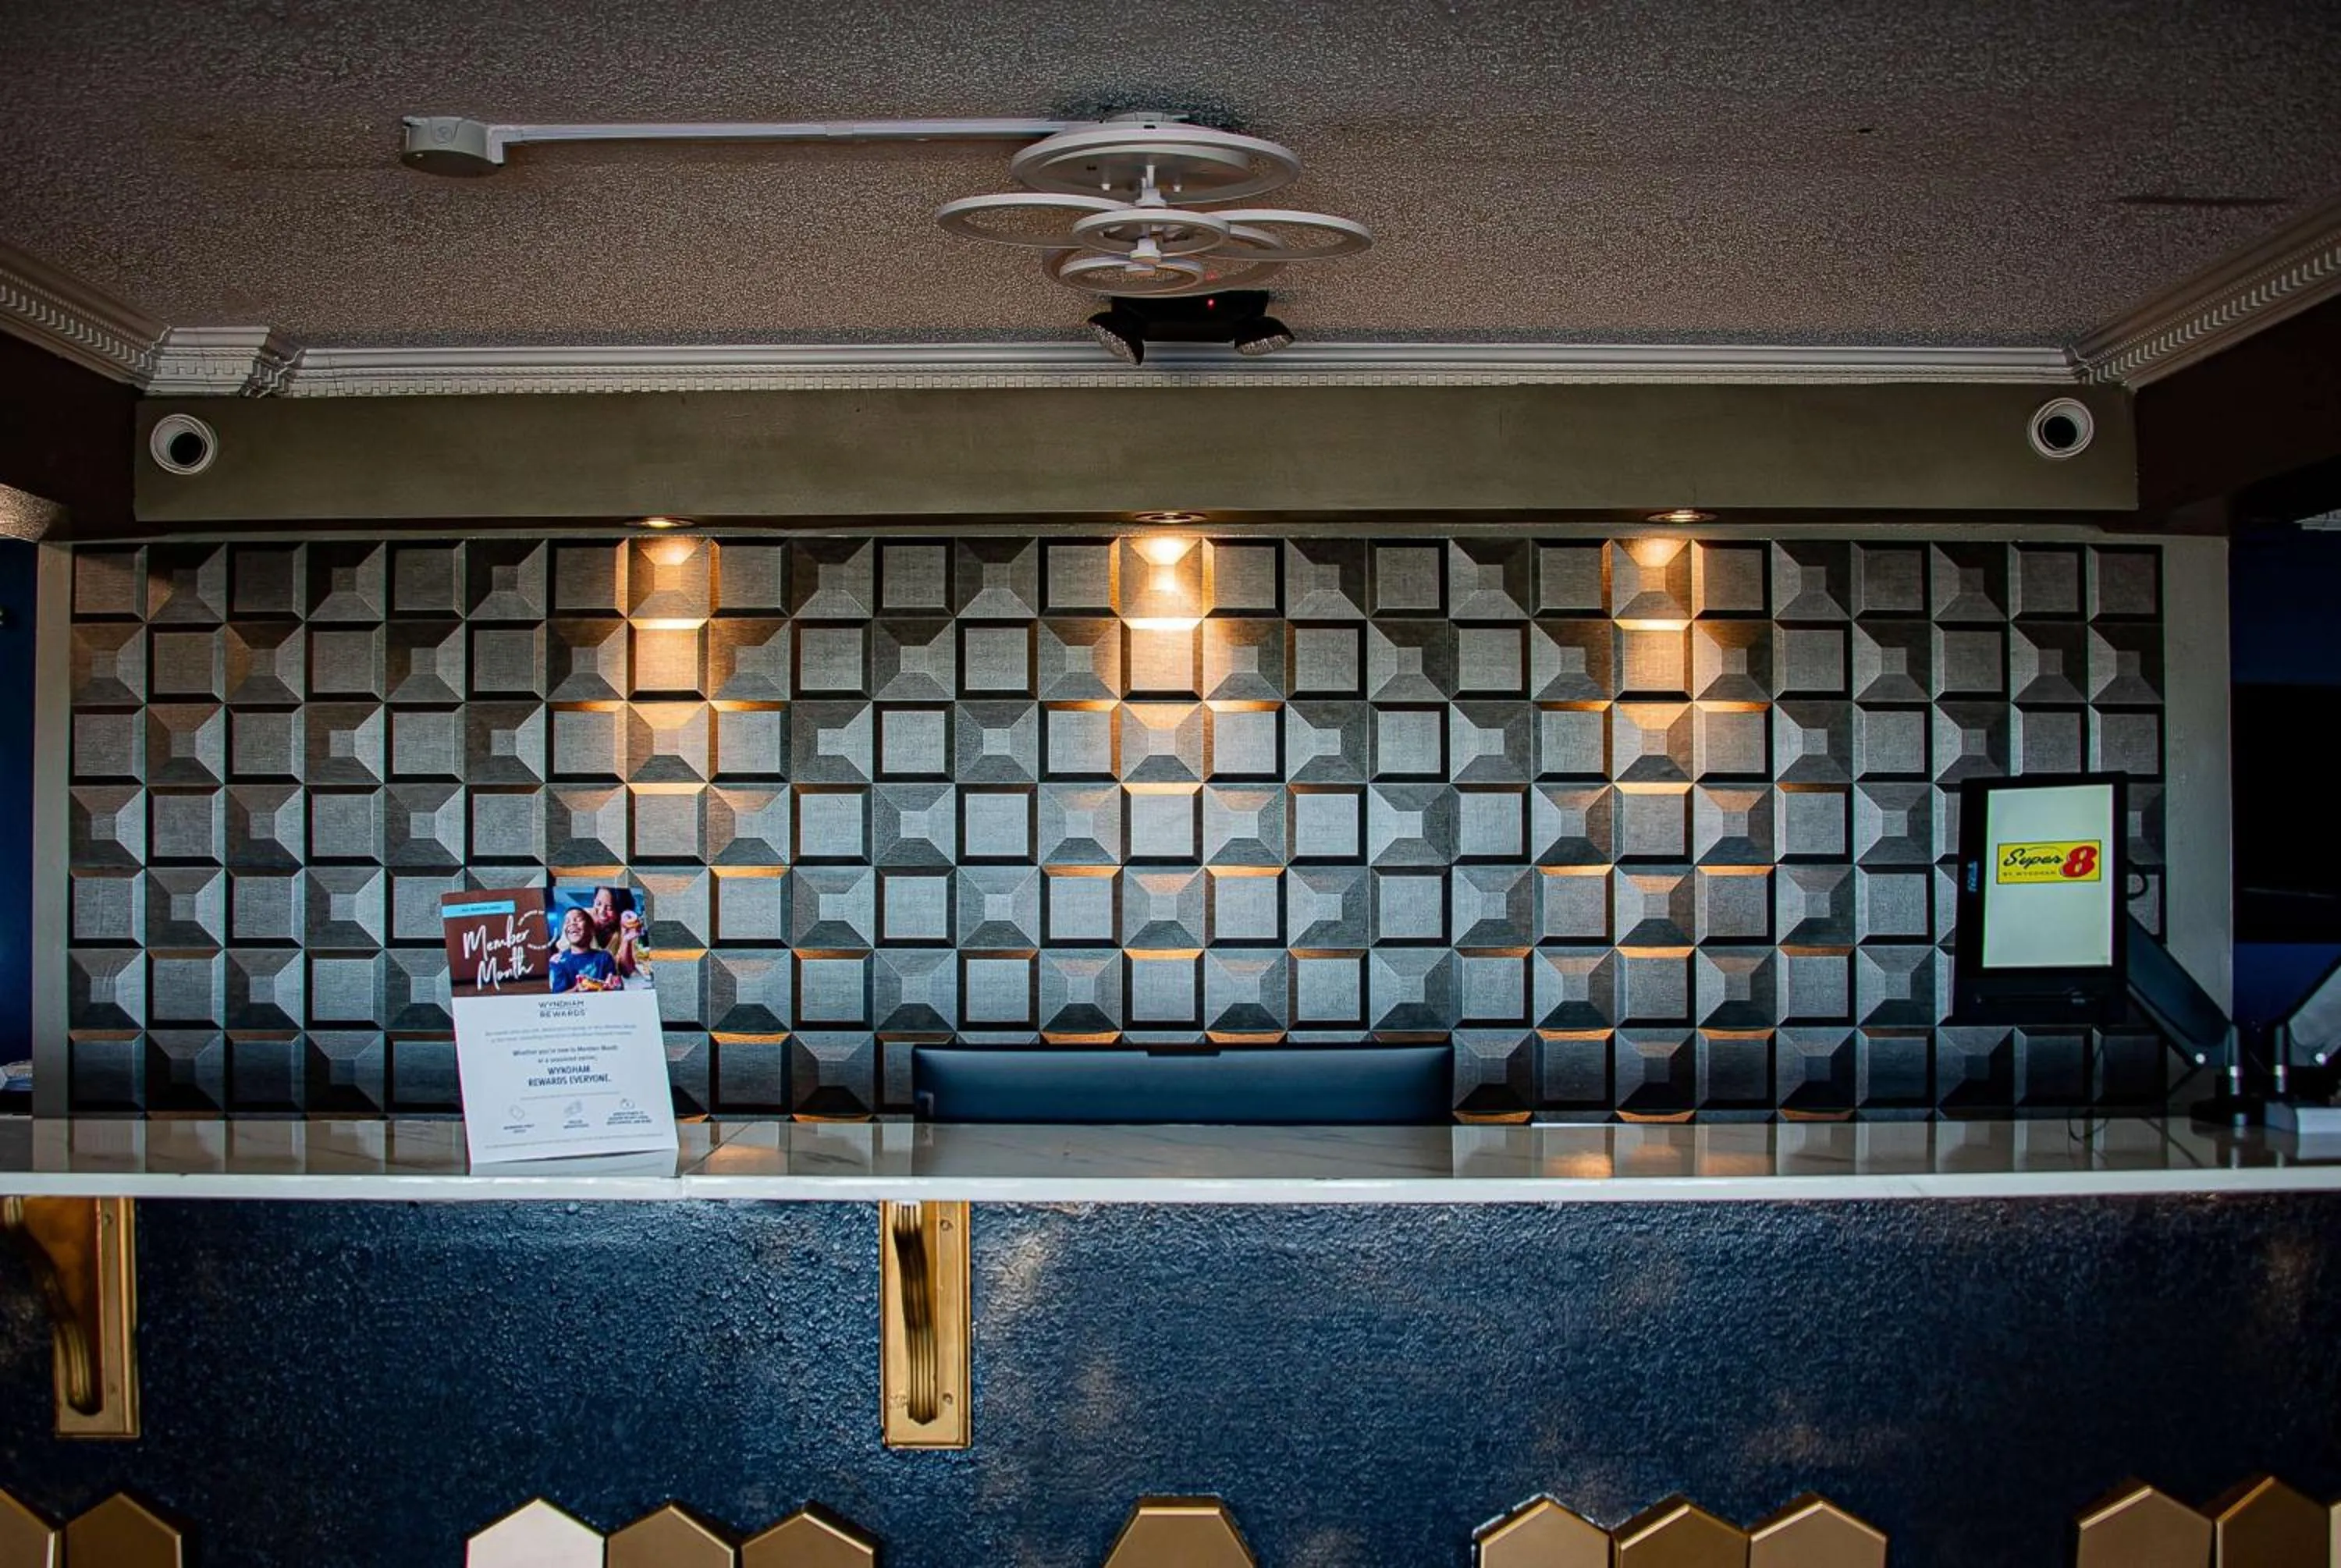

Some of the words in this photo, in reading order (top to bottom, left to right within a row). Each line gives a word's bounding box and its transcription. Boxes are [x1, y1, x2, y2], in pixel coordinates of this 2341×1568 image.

[2003, 848, 2063, 869] Super
[2060, 845, 2098, 878] 8
[462, 913, 530, 960] Member
[477, 945, 535, 991] Month
[528, 1077, 567, 1087] REWARDS
[569, 1073, 613, 1084] EVERYONE.
[547, 1065, 590, 1075] WYNDHAM
